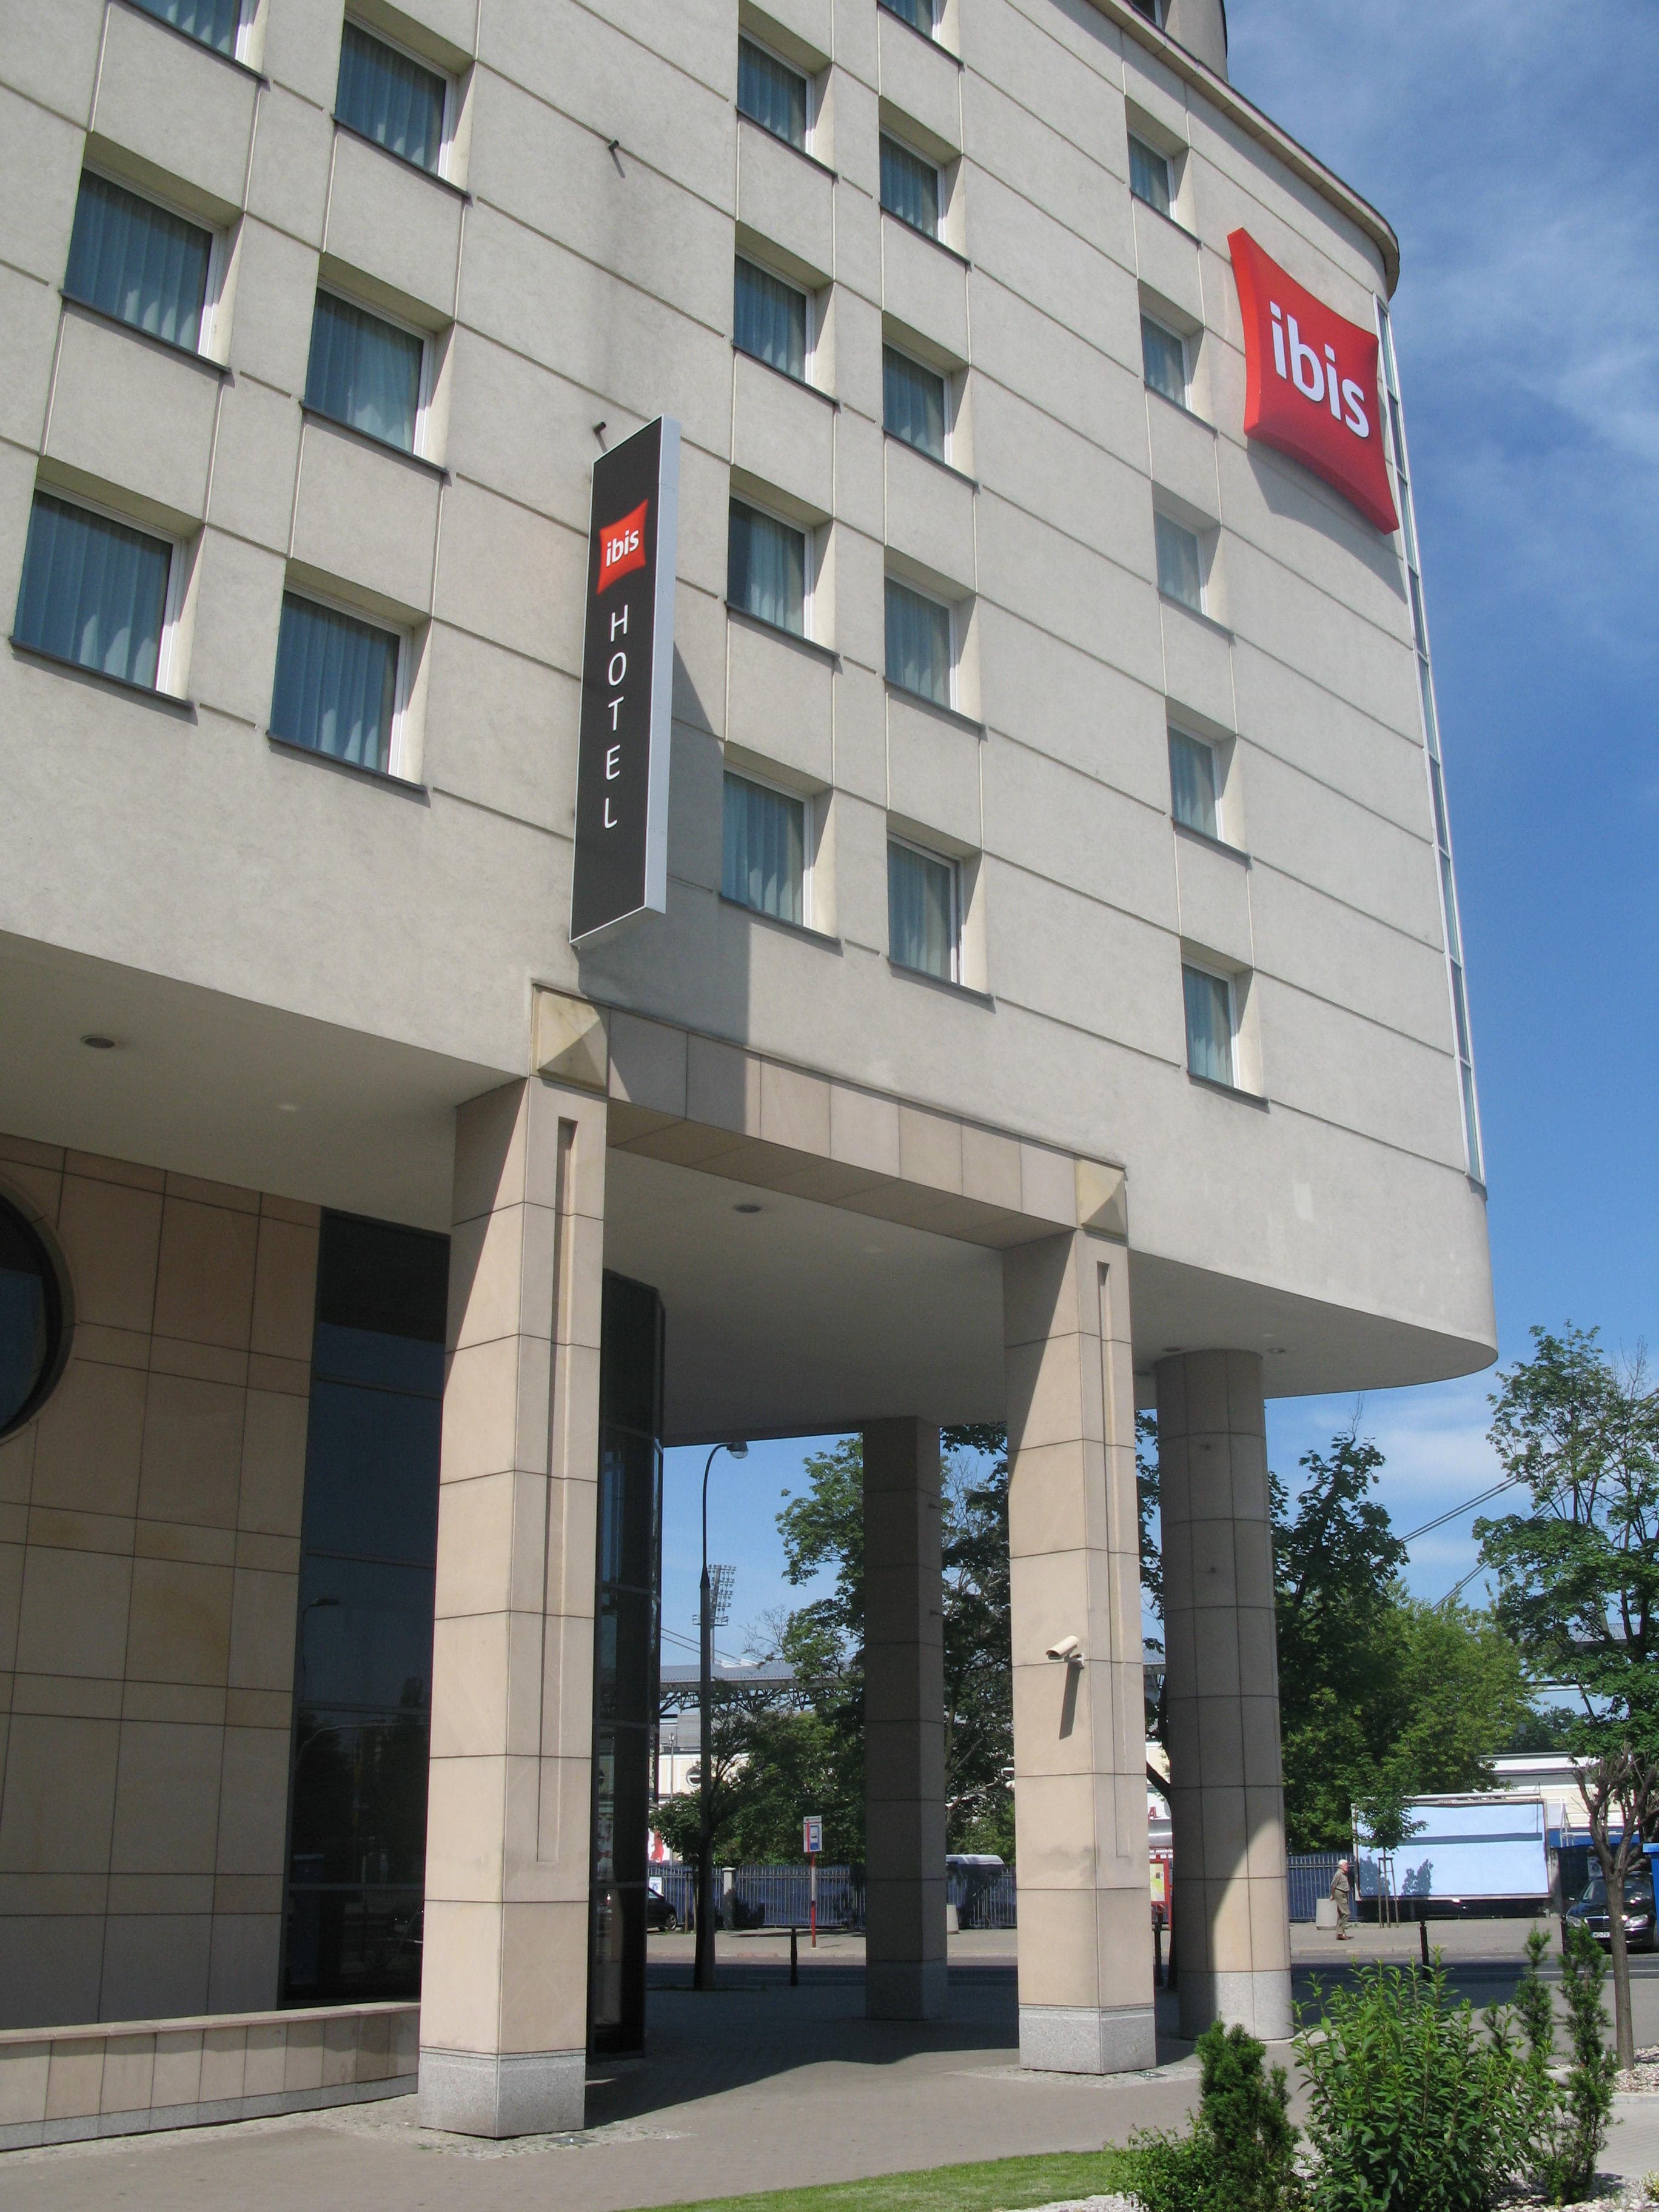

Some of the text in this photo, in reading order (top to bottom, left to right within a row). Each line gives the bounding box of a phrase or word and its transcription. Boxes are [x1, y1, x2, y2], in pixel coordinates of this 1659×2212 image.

[1270, 301, 1370, 438] ibis
[606, 529, 639, 568] ibis
[604, 604, 628, 829] HOTEL
